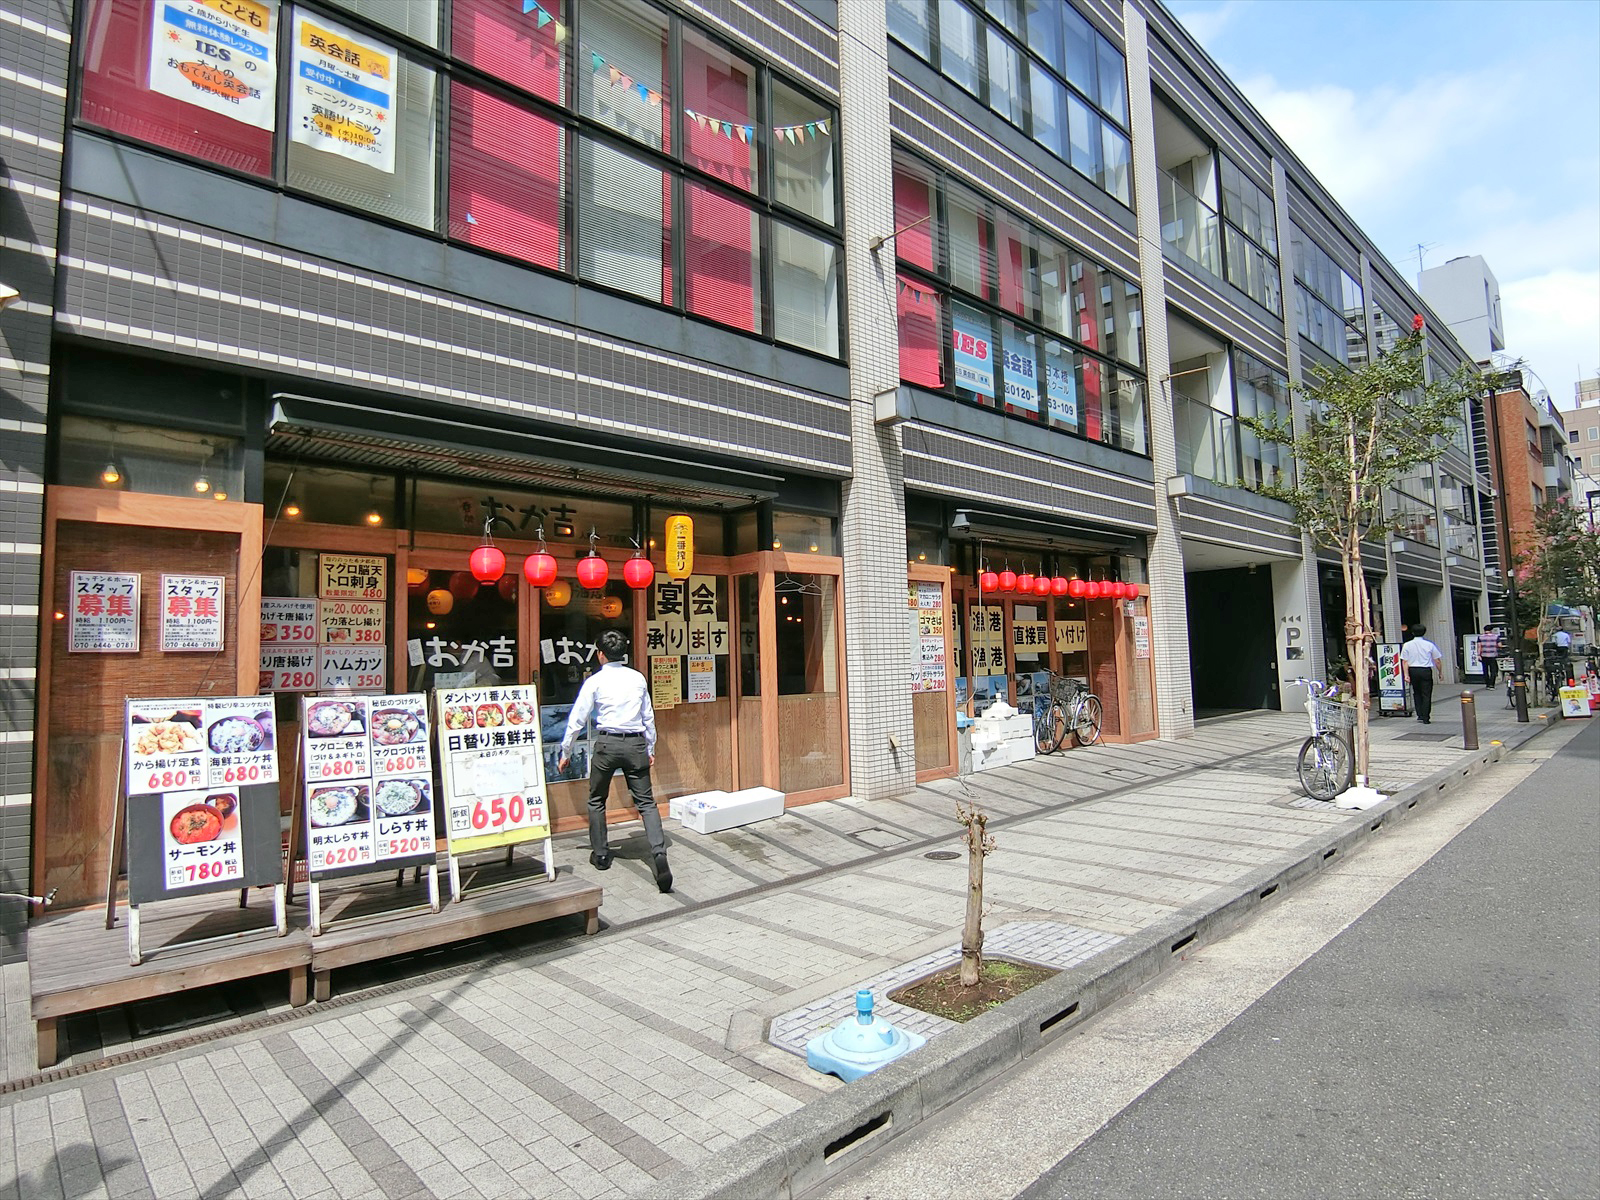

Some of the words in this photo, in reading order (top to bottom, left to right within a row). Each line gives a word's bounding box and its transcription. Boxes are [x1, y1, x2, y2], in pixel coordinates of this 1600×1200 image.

[195, 40, 232, 62] IES
[244, 61, 258, 72] の
[310, 33, 361, 68] 英会話
[197, 59, 235, 79] 大人の
[167, 57, 261, 100] おもてなし英会話
[191, 80, 240, 105] 毎週火曜日
[305, 84, 374, 118] モーニングクラス
[311, 103, 382, 137] 英語リトミック
[953, 329, 988, 360] IES
[480, 496, 579, 538] おか吉
[323, 563, 383, 576] マグロ脳天
[77, 582, 134, 595] スタッフ
[327, 574, 380, 589] トロ刺身
[168, 585, 219, 597] スタッフ
[362, 588, 382, 598] 480
[656, 581, 716, 616] 宴会
[77, 593, 134, 617] 募集
[167, 595, 219, 618] 募集
[322, 617, 382, 626] イカ落とし揚げ
[972, 610, 1001, 632] 漁港
[280, 625, 315, 640] 350
[355, 630, 381, 642] 380
[646, 627, 728, 650] 承ります
[1013, 625, 1048, 645] 直接買
[1054, 625, 1086, 644] い付け
[1286, 627, 1301, 646] P
[425, 635, 516, 668] おか吉
[973, 645, 1003, 668] 漁港
[260, 655, 314, 668] り唐揚げ
[323, 657, 382, 671] ハムカツ
[280, 672, 315, 688] 280
[357, 674, 382, 687] 350
[444, 689, 529, 704] ダントツ1番人気！
[310, 741, 365, 751] マグロ二色丼
[448, 729, 537, 751] 日替り海鮮丼
[209, 753, 273, 767] 海鮮ユッケ丼
[373, 745, 426, 757] マグロづけ丼
[133, 757, 201, 770] から揚げ定食
[321, 760, 354, 777] 680
[357, 765, 365, 774] 円
[385, 755, 416, 772] 680
[418, 761, 426, 769] 円
[147, 770, 187, 789] 680
[191, 776, 200, 785] 円
[224, 765, 260, 783] 680
[263, 770, 272, 779] 円
[526, 797, 543, 806] 税込
[471, 795, 526, 830] 650
[529, 807, 542, 822] 円
[379, 818, 428, 835] しらす丼
[313, 830, 370, 846] 明太しらす丼
[389, 837, 420, 855] 520
[422, 841, 431, 850] 円
[169, 841, 237, 860] サーモン丼
[325, 846, 358, 866] 620
[361, 851, 370, 860] 円
[185, 861, 224, 881] 780
[227, 865, 237, 875] 円
